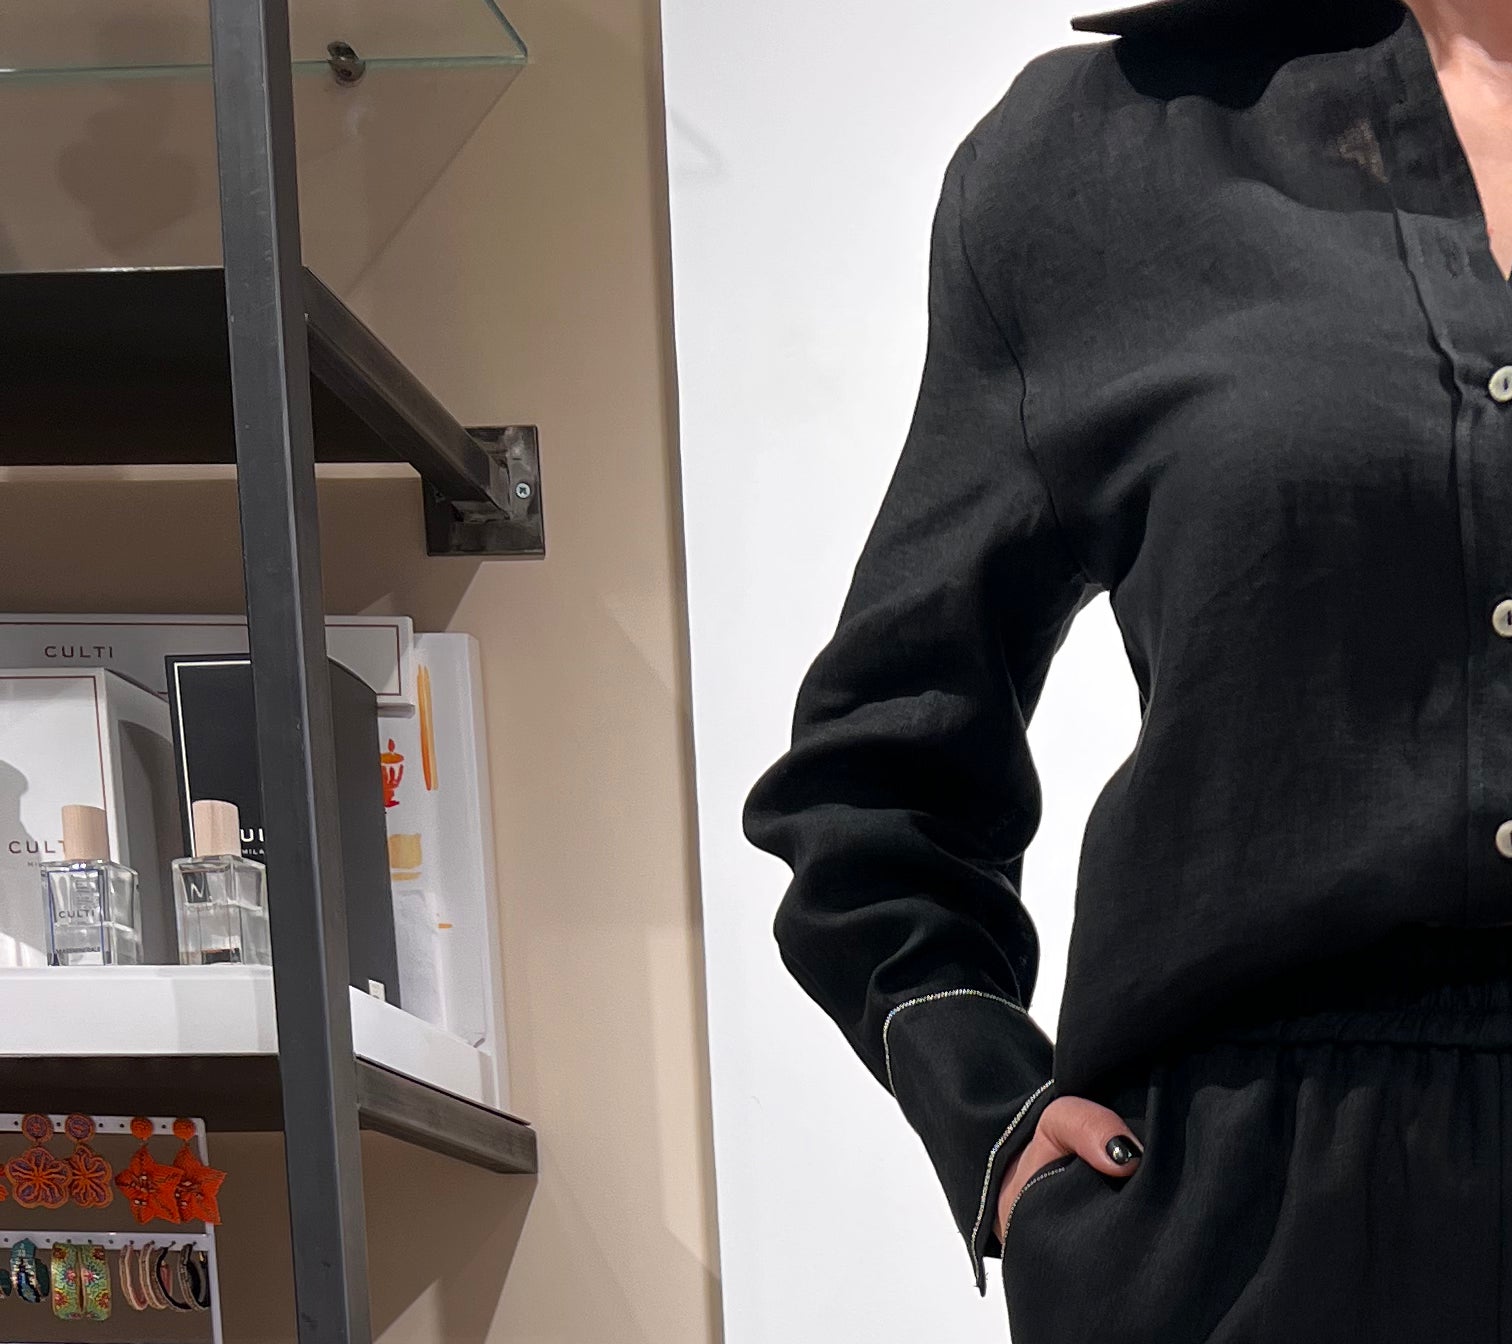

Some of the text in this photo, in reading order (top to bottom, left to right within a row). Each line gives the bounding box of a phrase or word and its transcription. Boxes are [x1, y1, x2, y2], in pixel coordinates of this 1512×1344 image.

[44, 645, 114, 659] CULTI
[8, 840, 64, 854] CUL
[58, 909, 95, 919] CULTI
